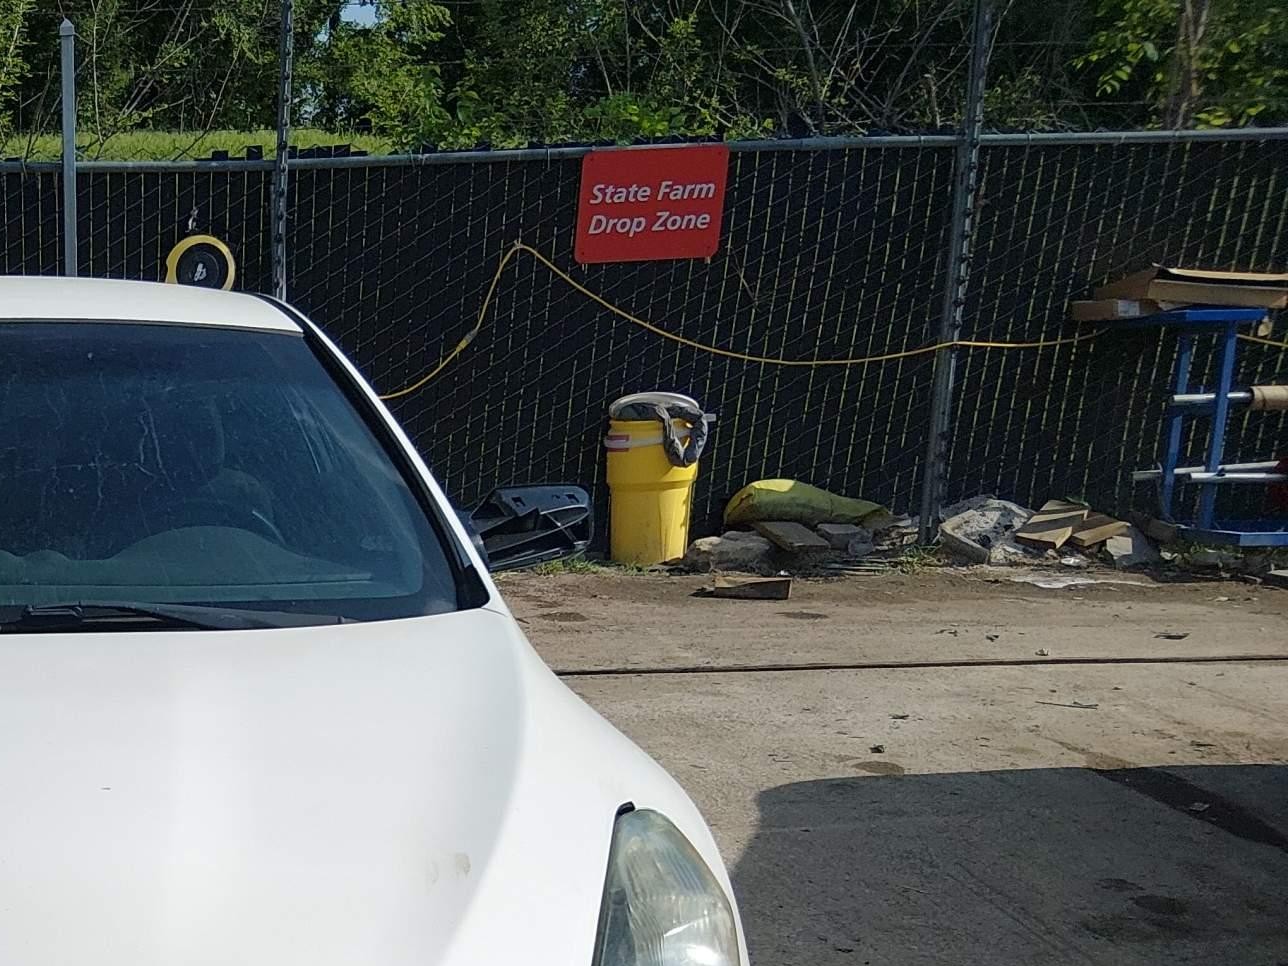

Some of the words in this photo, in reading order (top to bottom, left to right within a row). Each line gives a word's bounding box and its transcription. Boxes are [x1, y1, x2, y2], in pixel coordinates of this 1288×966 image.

[589, 182, 651, 204] State
[657, 180, 715, 201] Farm
[588, 211, 646, 238] Drop
[651, 211, 711, 232] Zone
